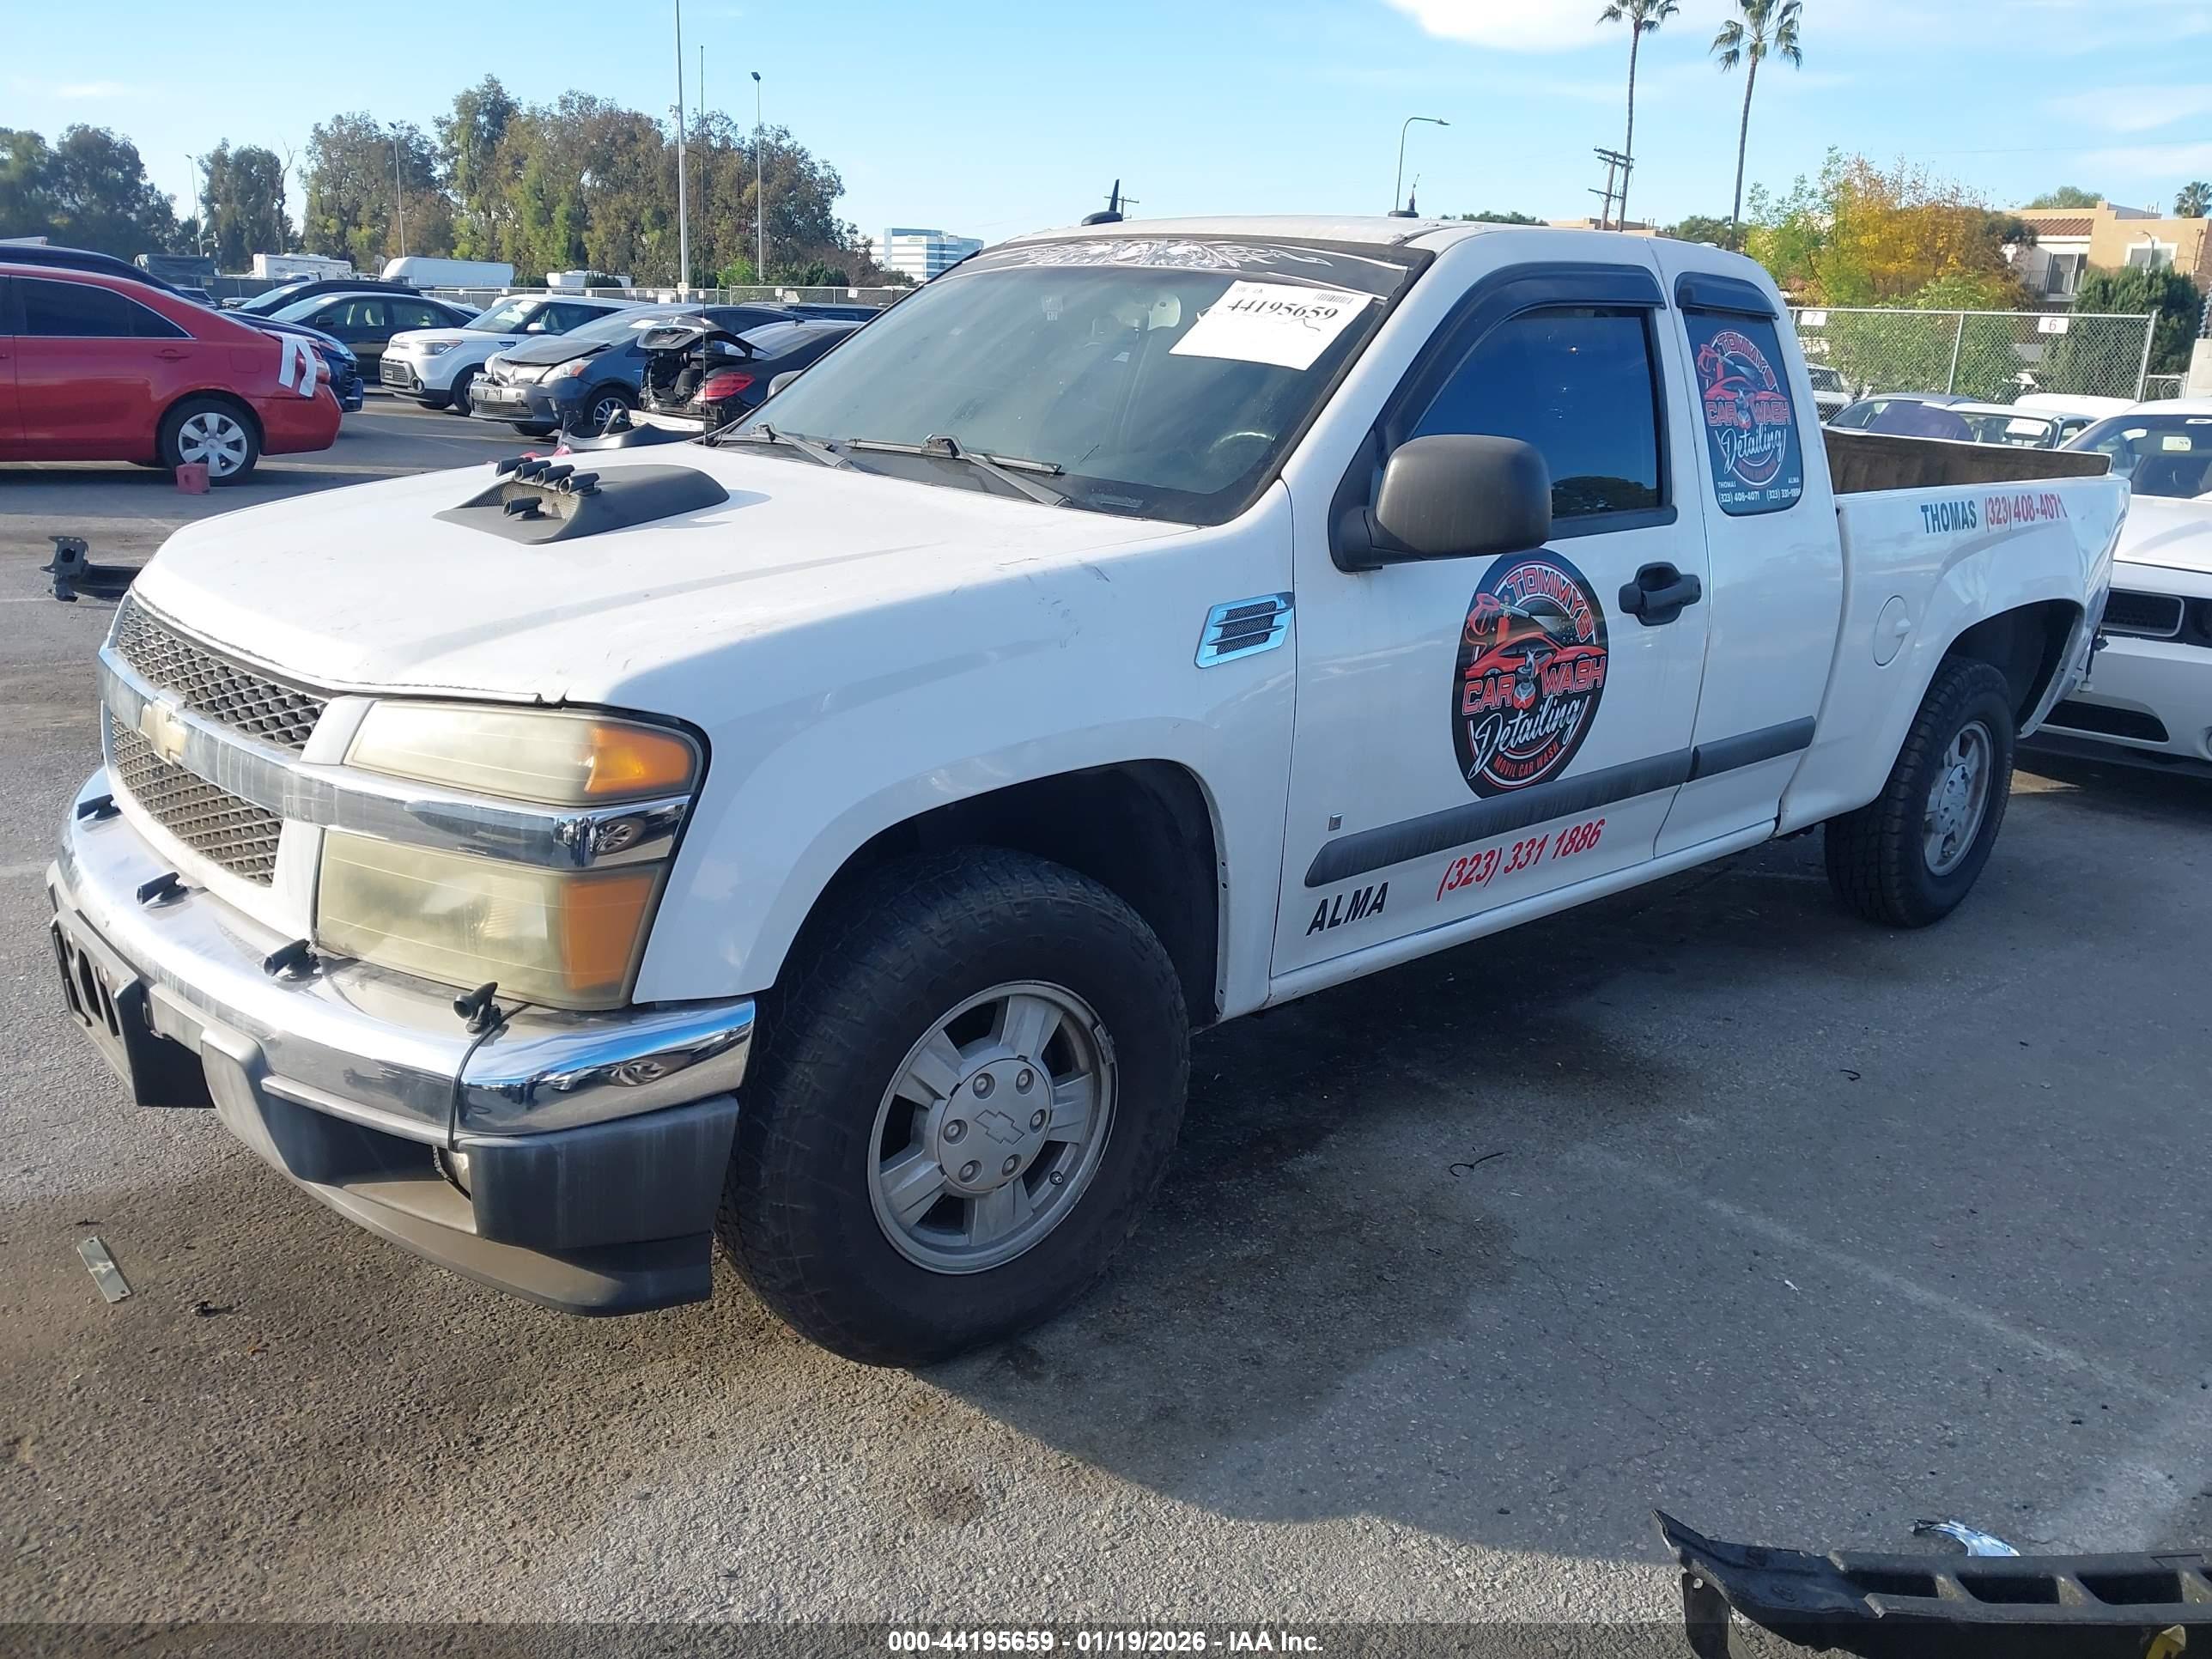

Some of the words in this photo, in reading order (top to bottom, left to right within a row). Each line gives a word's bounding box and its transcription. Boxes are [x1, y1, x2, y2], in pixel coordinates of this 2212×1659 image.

[1227, 298, 1340, 321] 44195659
[1810, 312, 1818, 325] 7
[2049, 319, 2057, 331] 6
[1705, 401, 1739, 427] CAR
[1751, 400, 1792, 426] WASH
[1721, 422, 1782, 474] Detailing
[1717, 480, 1737, 489] THOMAS
[1717, 490, 1733, 505] (323)
[1734, 490, 1760, 502] 408-4071
[1766, 488, 1781, 502] (323)
[1920, 500, 1977, 534] THOMAS
[1984, 495, 2011, 533] (323)
[2013, 494, 2068, 523] 408-4071
[1462, 674, 1516, 716] CAR
[1540, 656, 1607, 699] WASH
[1468, 696, 1584, 780] Detailing
[1493, 755, 1517, 778] MOVIL
[1518, 761, 1534, 777] CAR
[1536, 741, 1560, 770] WASH
[1436, 847, 1503, 902] (323)
[1504, 833, 1549, 875] 331
[1552, 817, 1607, 860] 1886
[1305, 881, 1389, 936] ALMA
